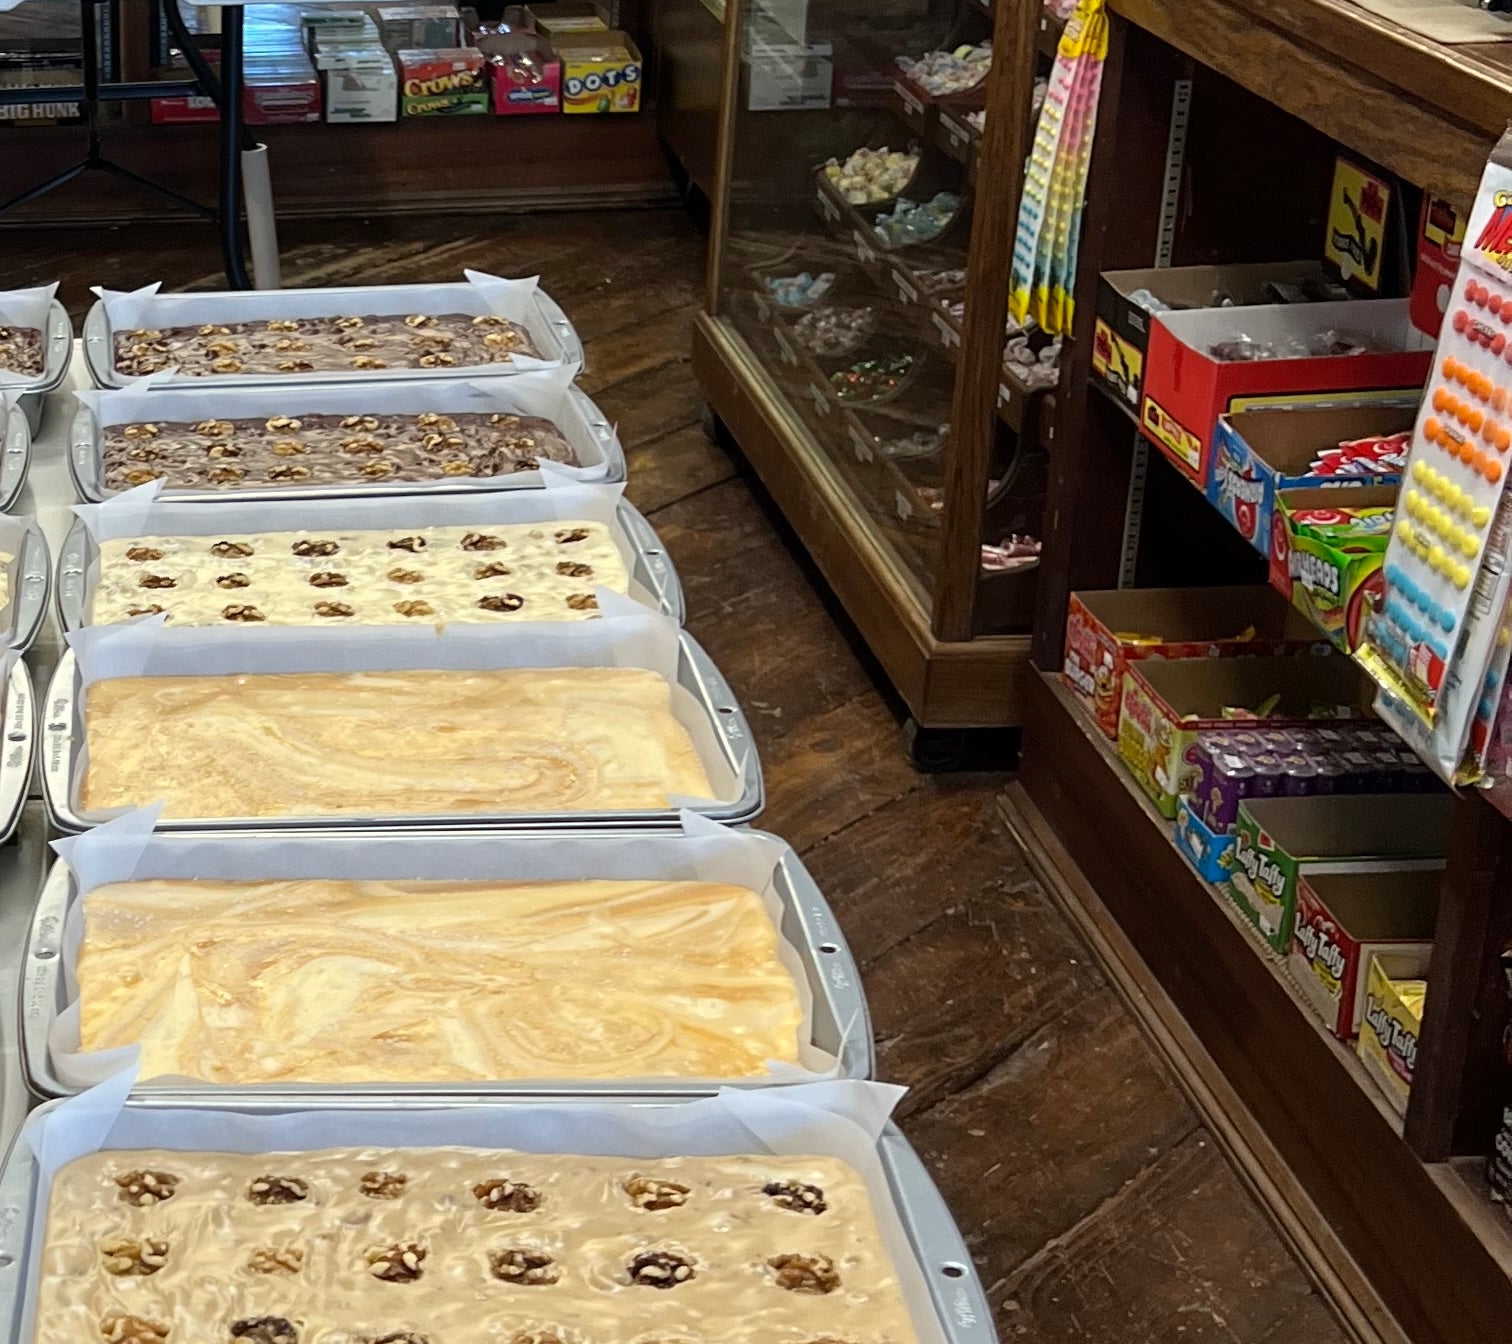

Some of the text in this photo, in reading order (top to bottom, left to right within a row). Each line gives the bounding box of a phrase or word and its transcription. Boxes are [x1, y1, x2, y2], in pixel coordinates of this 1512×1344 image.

[403, 68, 474, 98] Crows
[568, 66, 638, 95] DOTS
[35, 102, 81, 119] HUNK
[1236, 836, 1286, 897] Laffy Taffy
[1294, 911, 1346, 979] Laffy Taffy
[1365, 994, 1418, 1070] Laffy Taffy
